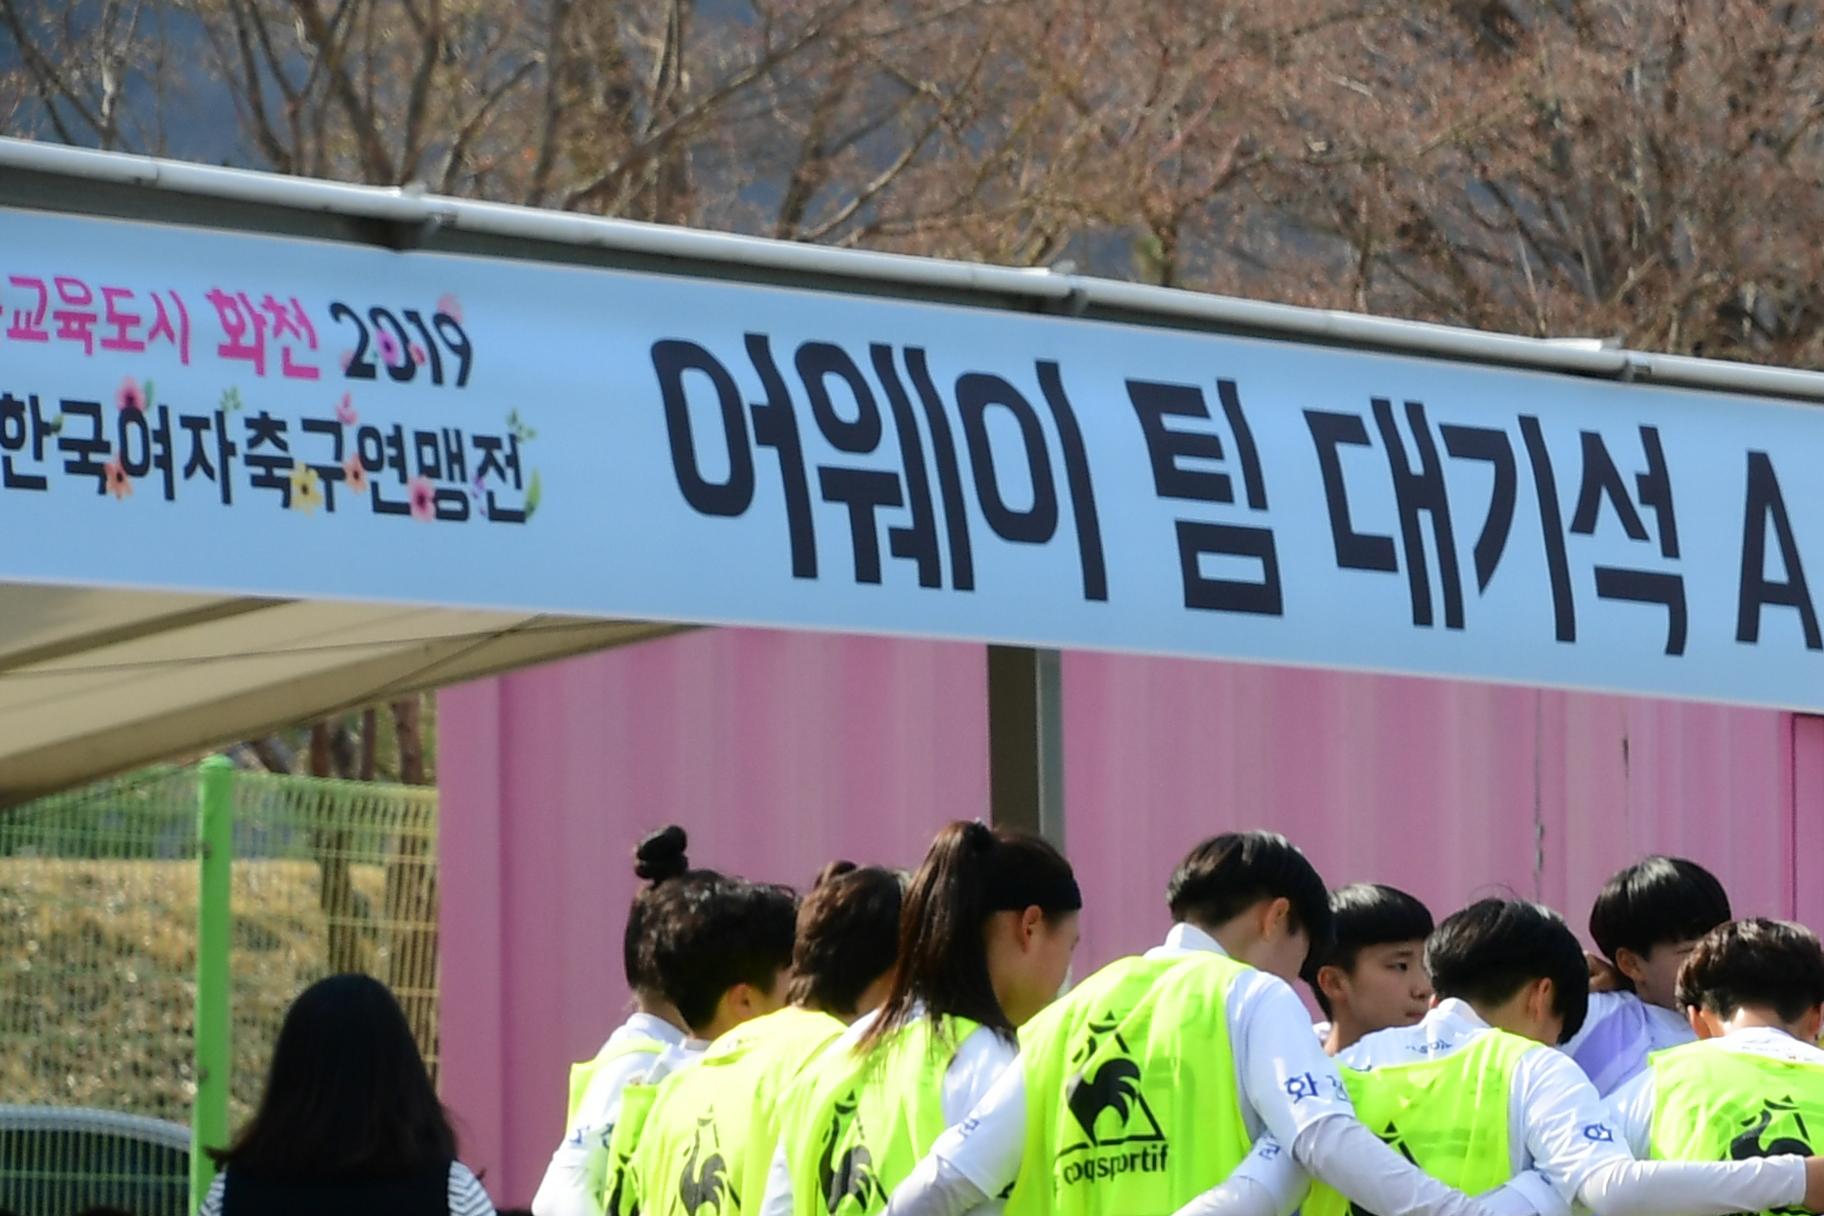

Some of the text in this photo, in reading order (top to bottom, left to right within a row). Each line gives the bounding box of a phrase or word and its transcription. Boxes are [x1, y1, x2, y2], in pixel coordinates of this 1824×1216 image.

[205, 287, 321, 381] 화천
[329, 302, 474, 388] 2019
[649, 332, 1824, 658] 어웨이 팀 대기석 A
